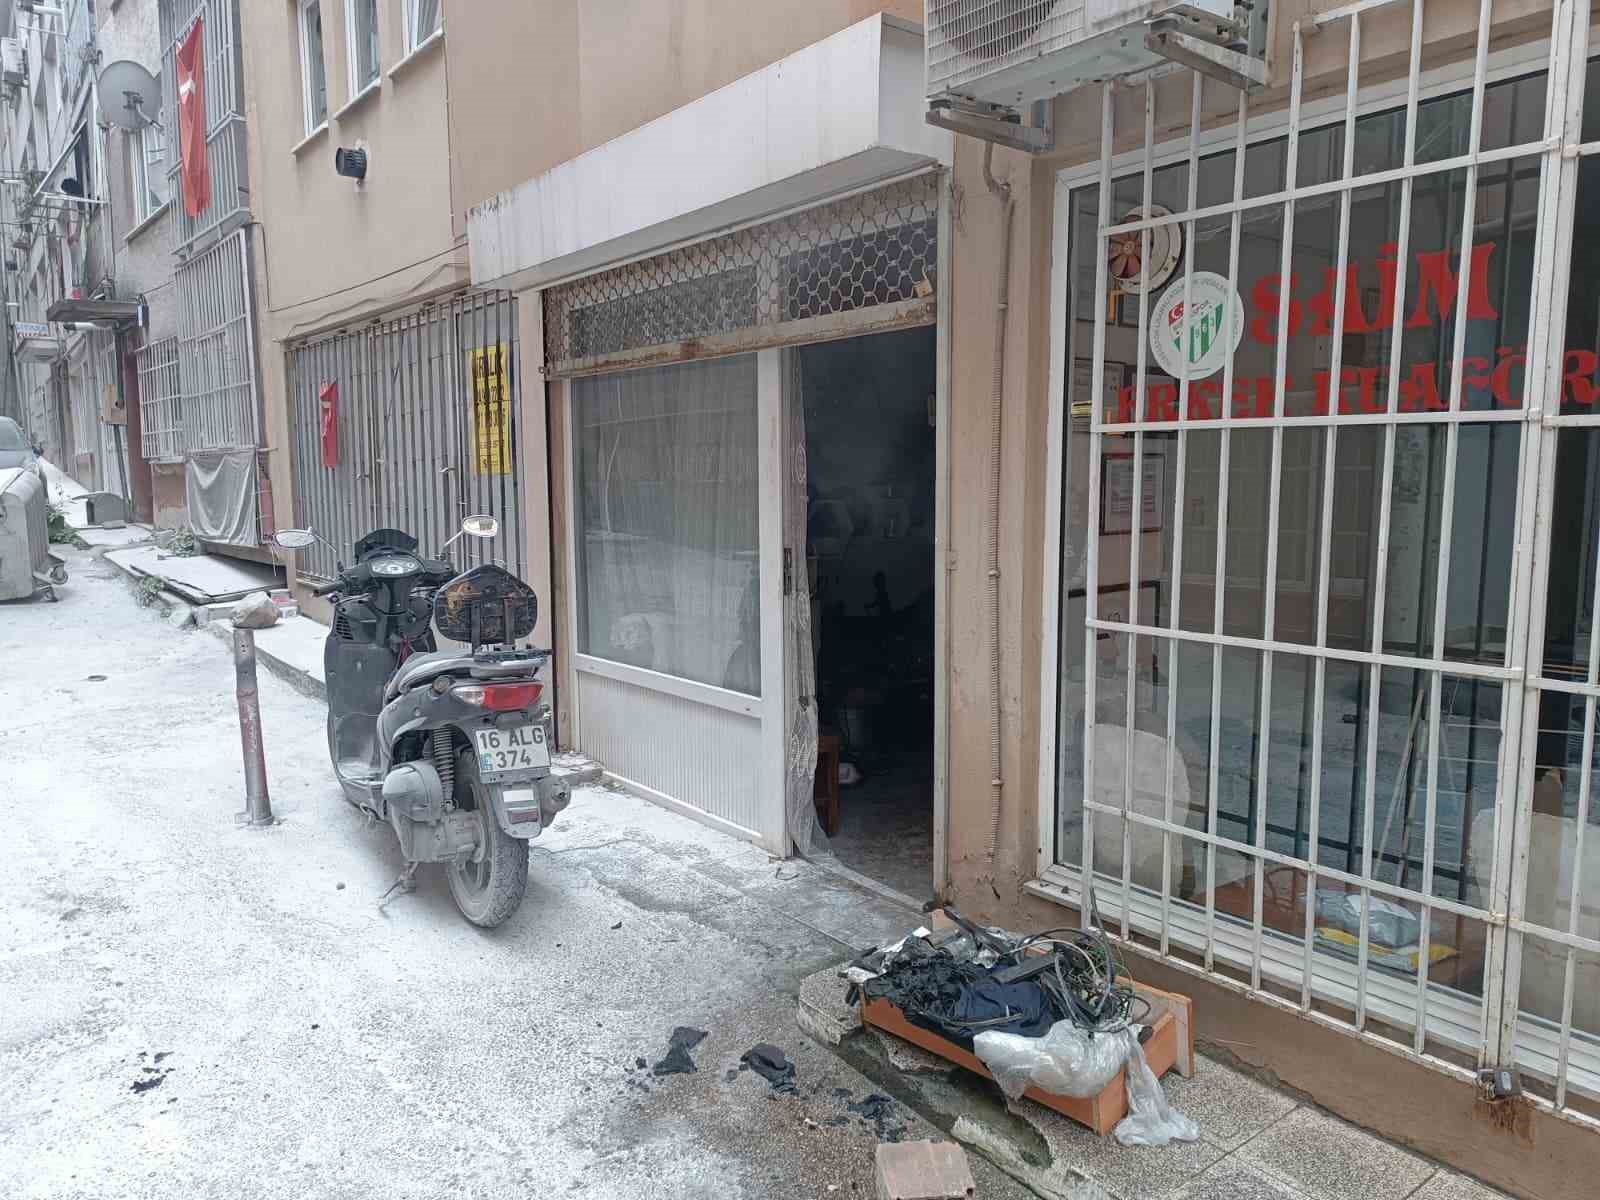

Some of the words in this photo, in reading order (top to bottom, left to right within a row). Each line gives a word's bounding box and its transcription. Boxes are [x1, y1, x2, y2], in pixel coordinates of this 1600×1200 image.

[479, 731, 501, 750] 16
[508, 727, 544, 748] ALG
[495, 750, 532, 769] 374
